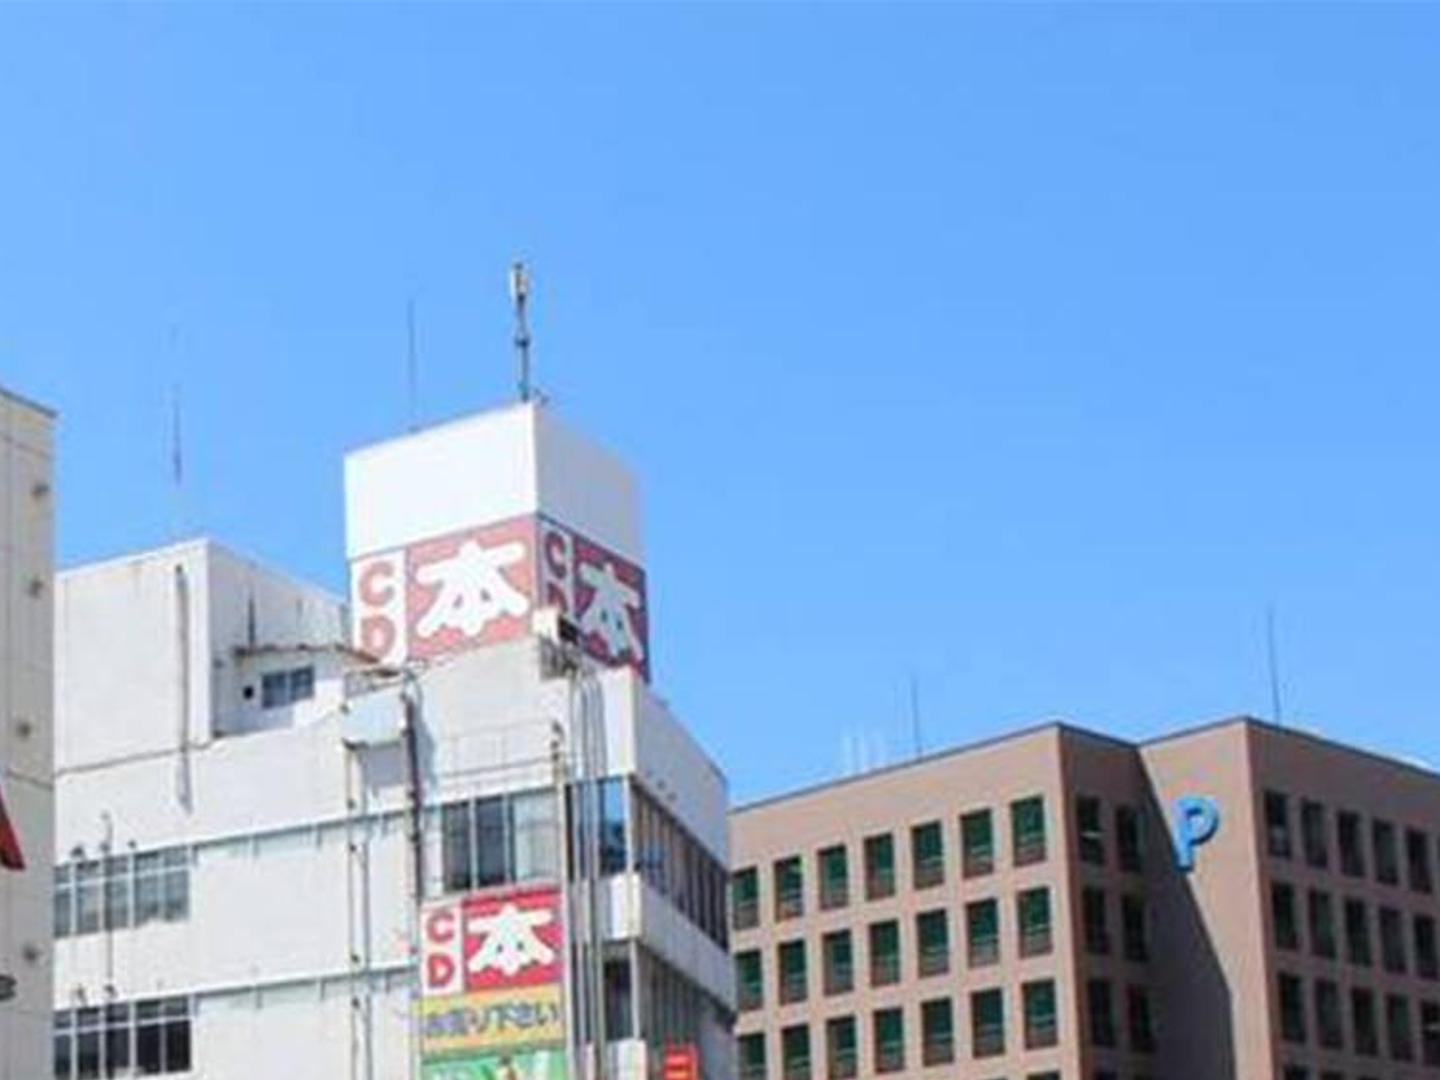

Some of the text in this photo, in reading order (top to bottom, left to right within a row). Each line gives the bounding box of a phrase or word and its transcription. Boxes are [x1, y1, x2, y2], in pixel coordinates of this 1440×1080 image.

[416, 540, 530, 638] 本
[579, 560, 641, 662] 本
[1176, 797, 1219, 872] P
[426, 911, 456, 989] CD
[467, 904, 556, 976] 本
